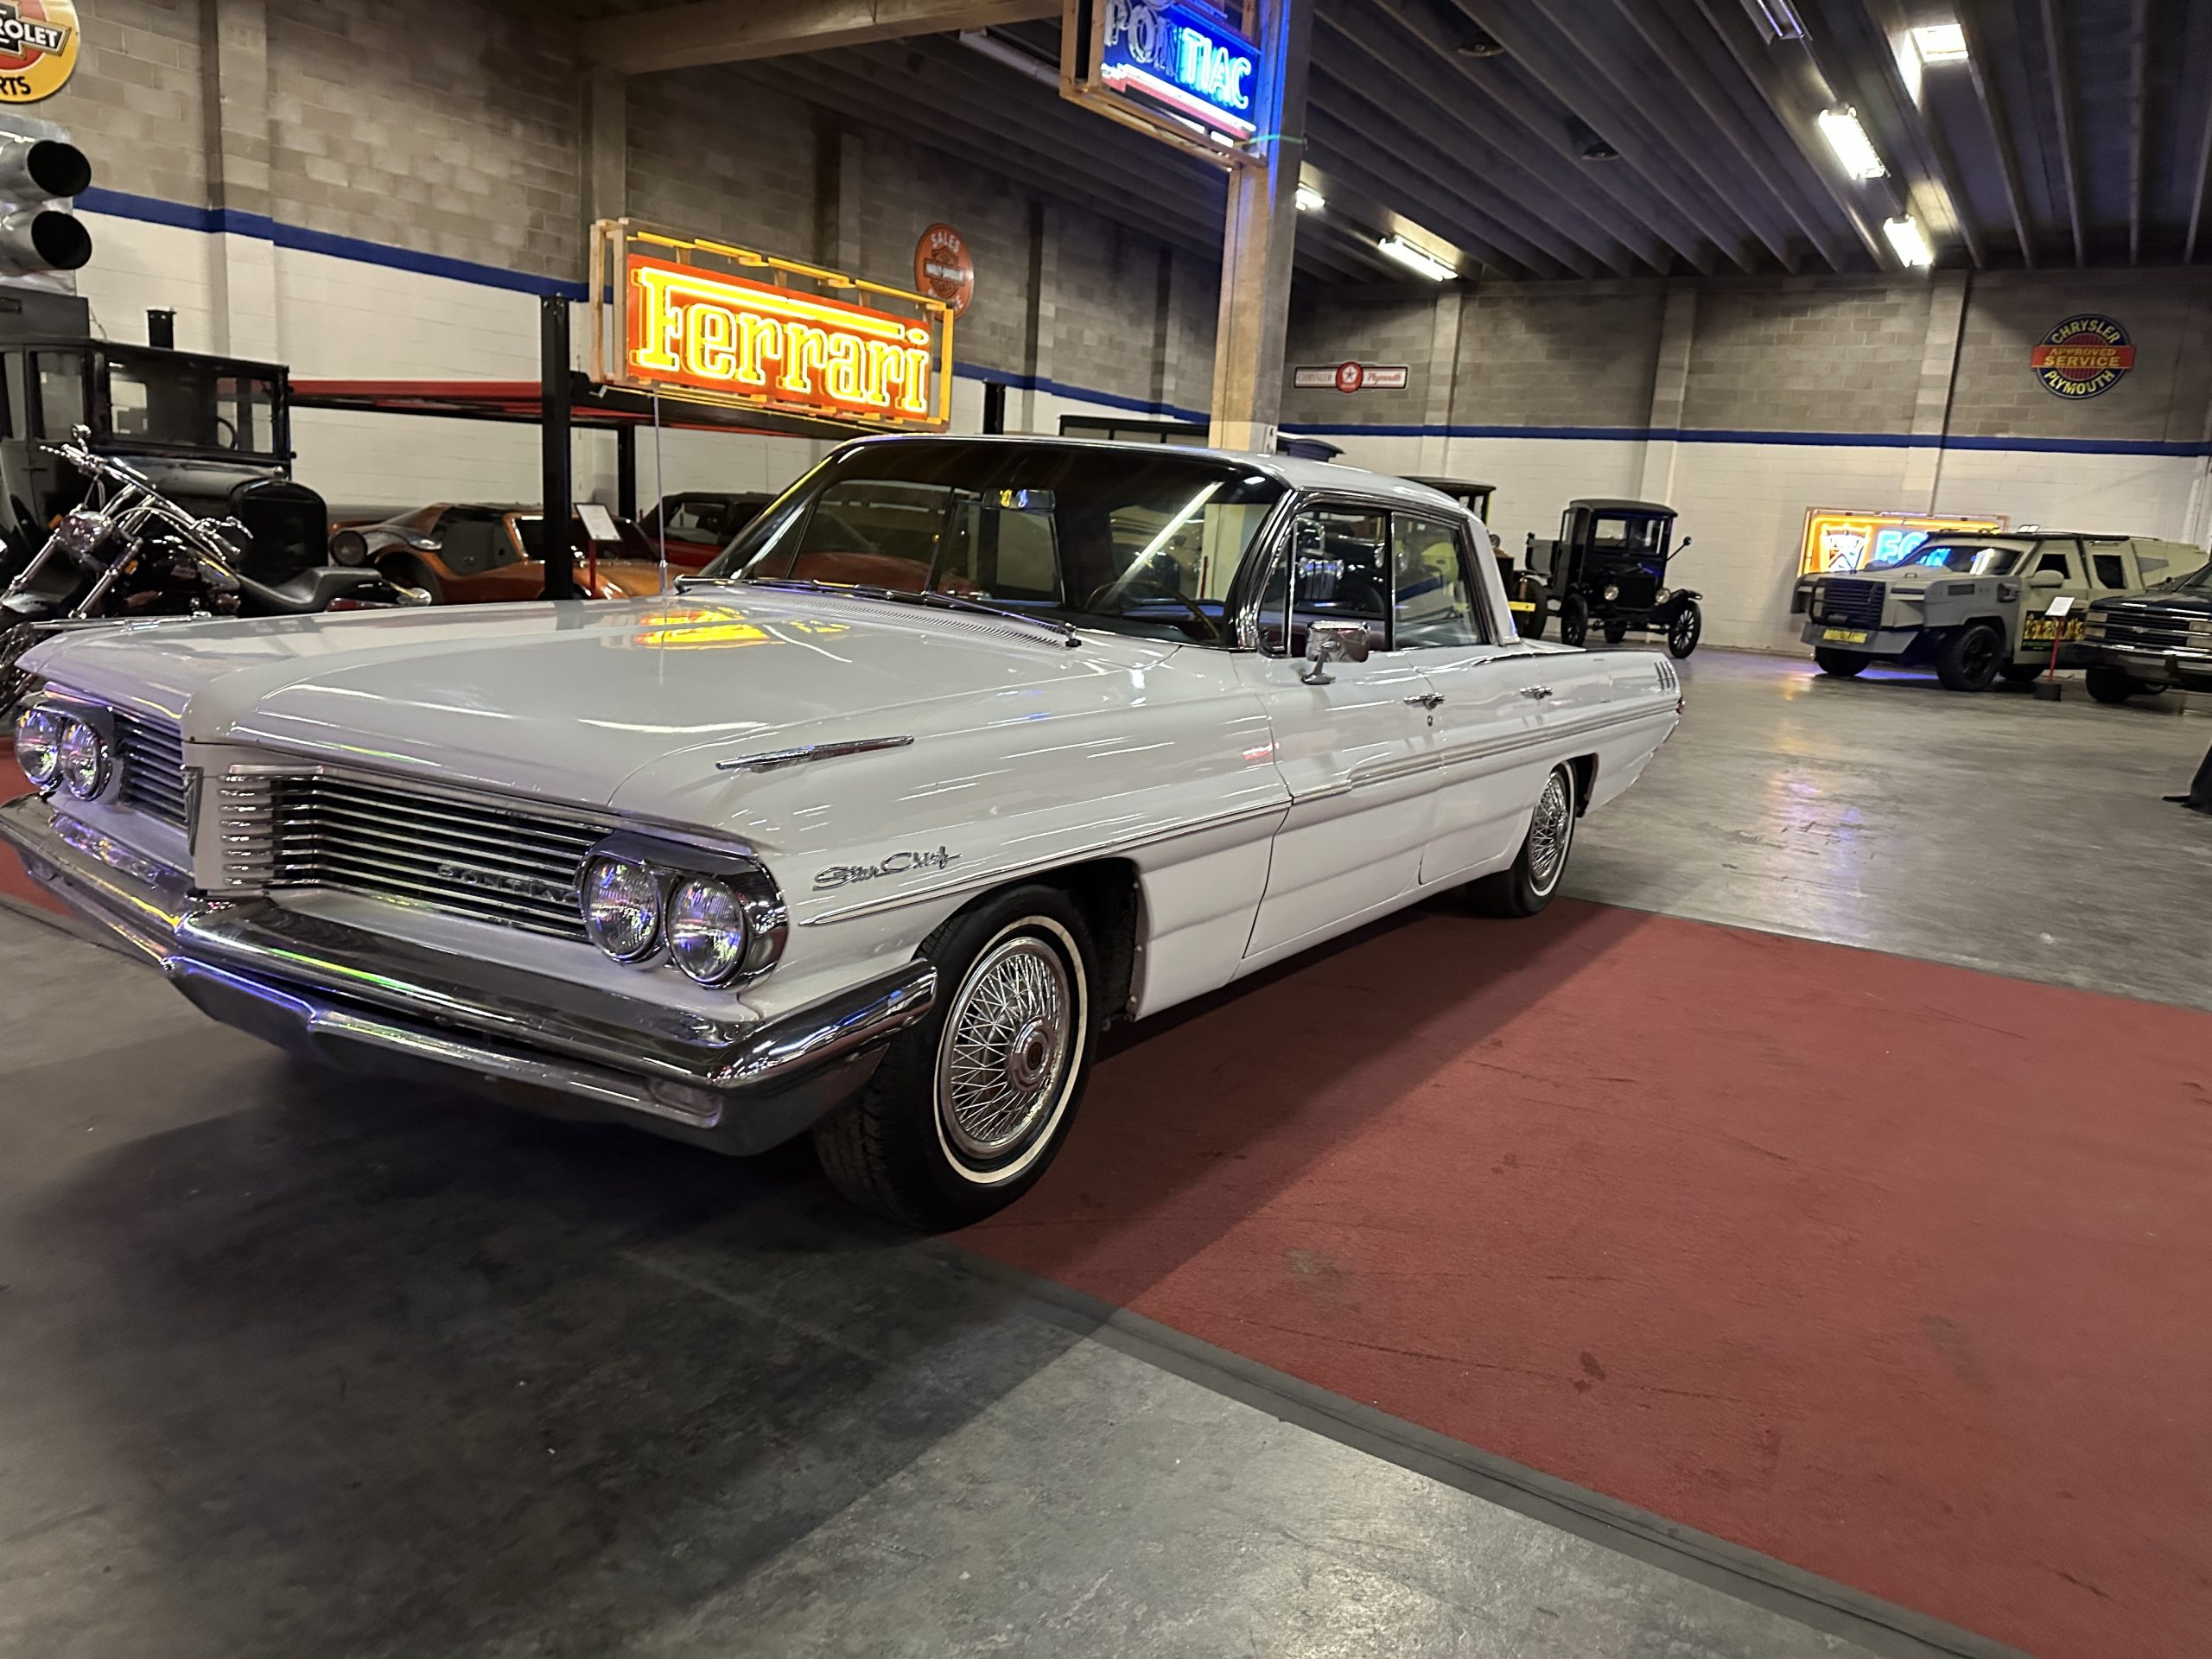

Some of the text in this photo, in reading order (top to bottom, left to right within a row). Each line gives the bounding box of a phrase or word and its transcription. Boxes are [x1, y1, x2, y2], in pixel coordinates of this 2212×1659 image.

[1104, 0, 1252, 110] PONTIAC
[931, 230, 960, 253] SALES
[632, 266, 930, 414] Ferrari
[2051, 319, 2121, 344] CHRYSLER
[2044, 356, 2121, 367] SERVICE
[2049, 347, 2117, 356] APPROVED
[2044, 369, 2116, 395] PLYMOUTH
[812, 845, 963, 892] Star Chief
